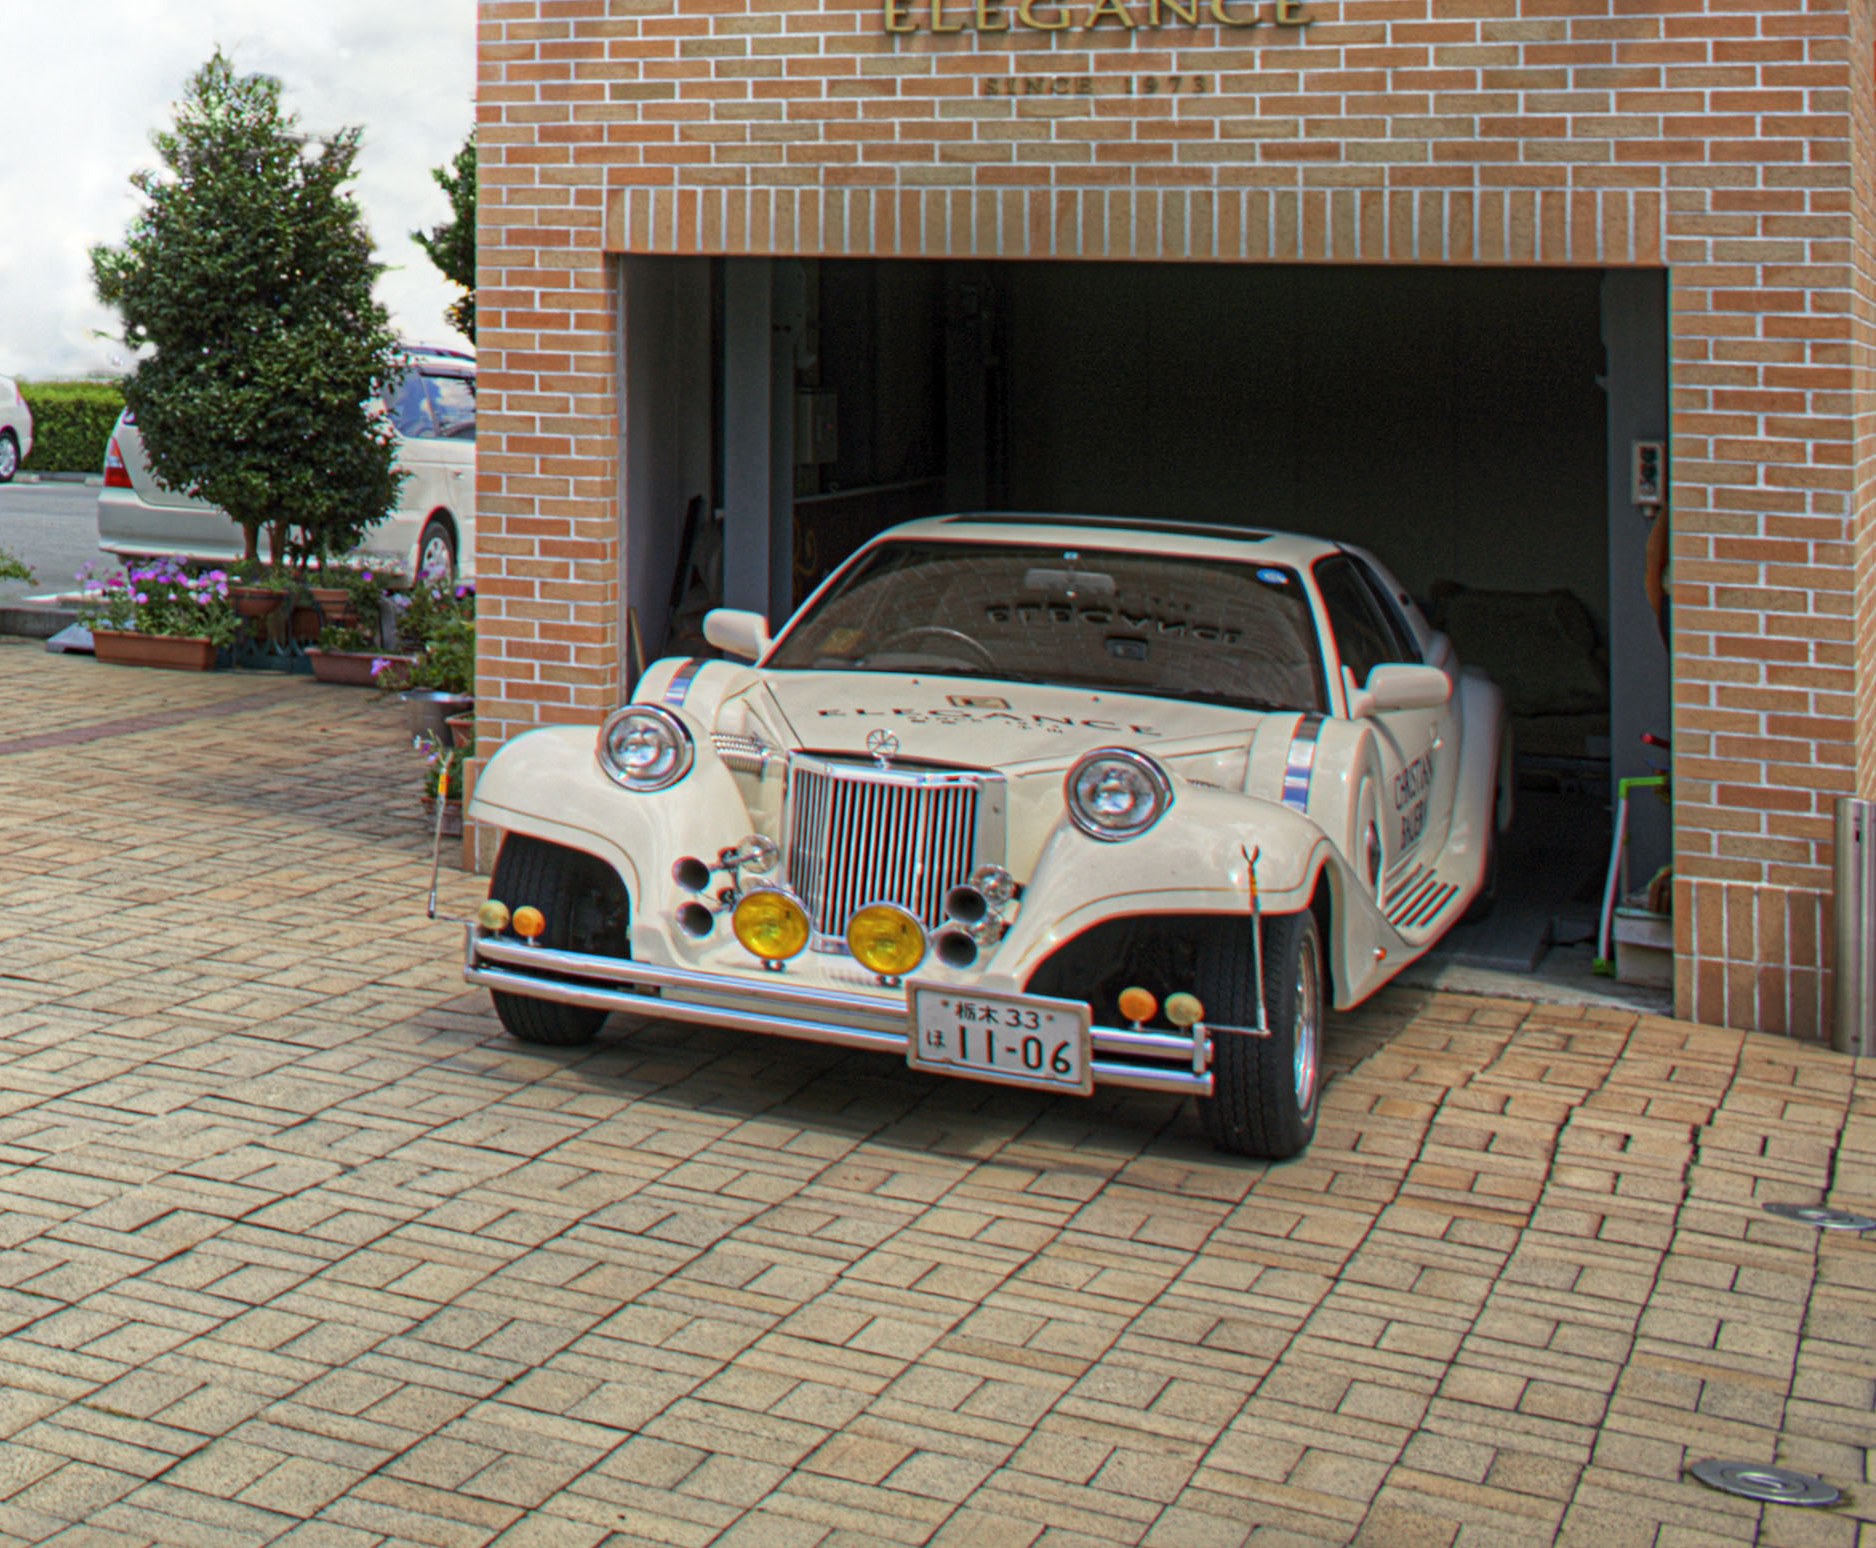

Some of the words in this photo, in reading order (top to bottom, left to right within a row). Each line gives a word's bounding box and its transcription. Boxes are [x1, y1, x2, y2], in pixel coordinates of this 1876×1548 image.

[984, 76, 1094, 95] SINCE
[1124, 75, 1208, 95] 1973
[817, 707, 1163, 736] ELEGANCE
[1004, 1008, 1040, 1030] 33
[958, 1025, 1072, 1074] 11-06
